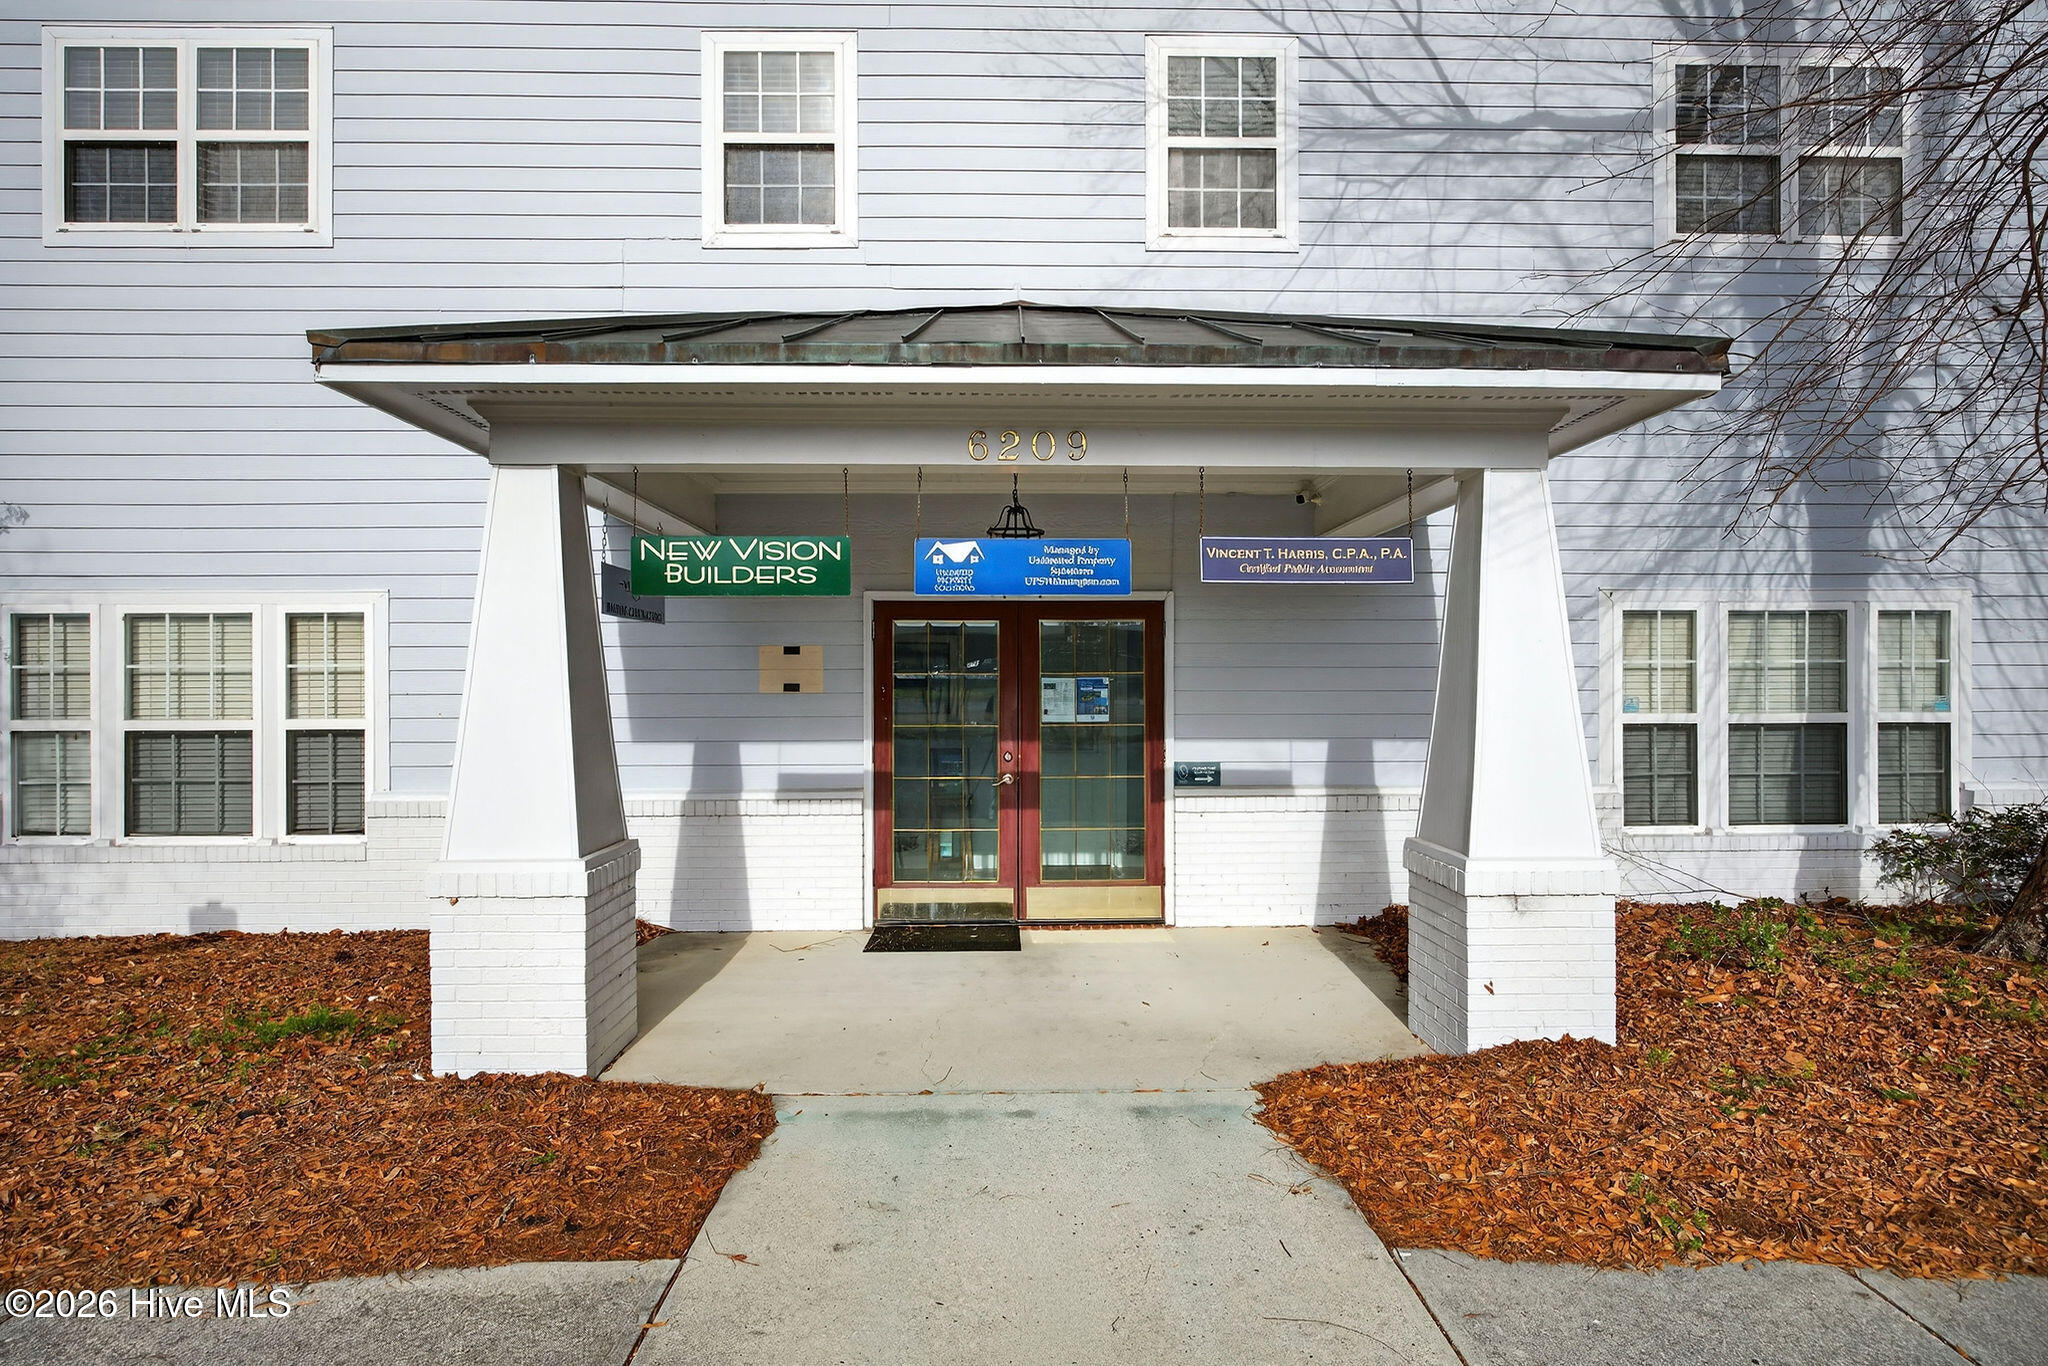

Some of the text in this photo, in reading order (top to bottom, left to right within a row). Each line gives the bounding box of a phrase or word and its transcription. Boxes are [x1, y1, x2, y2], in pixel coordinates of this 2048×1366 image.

[968, 429, 1088, 461] 6209
[1380, 547, 1408, 559] P.A.
[664, 563, 818, 584] BUILDERS
